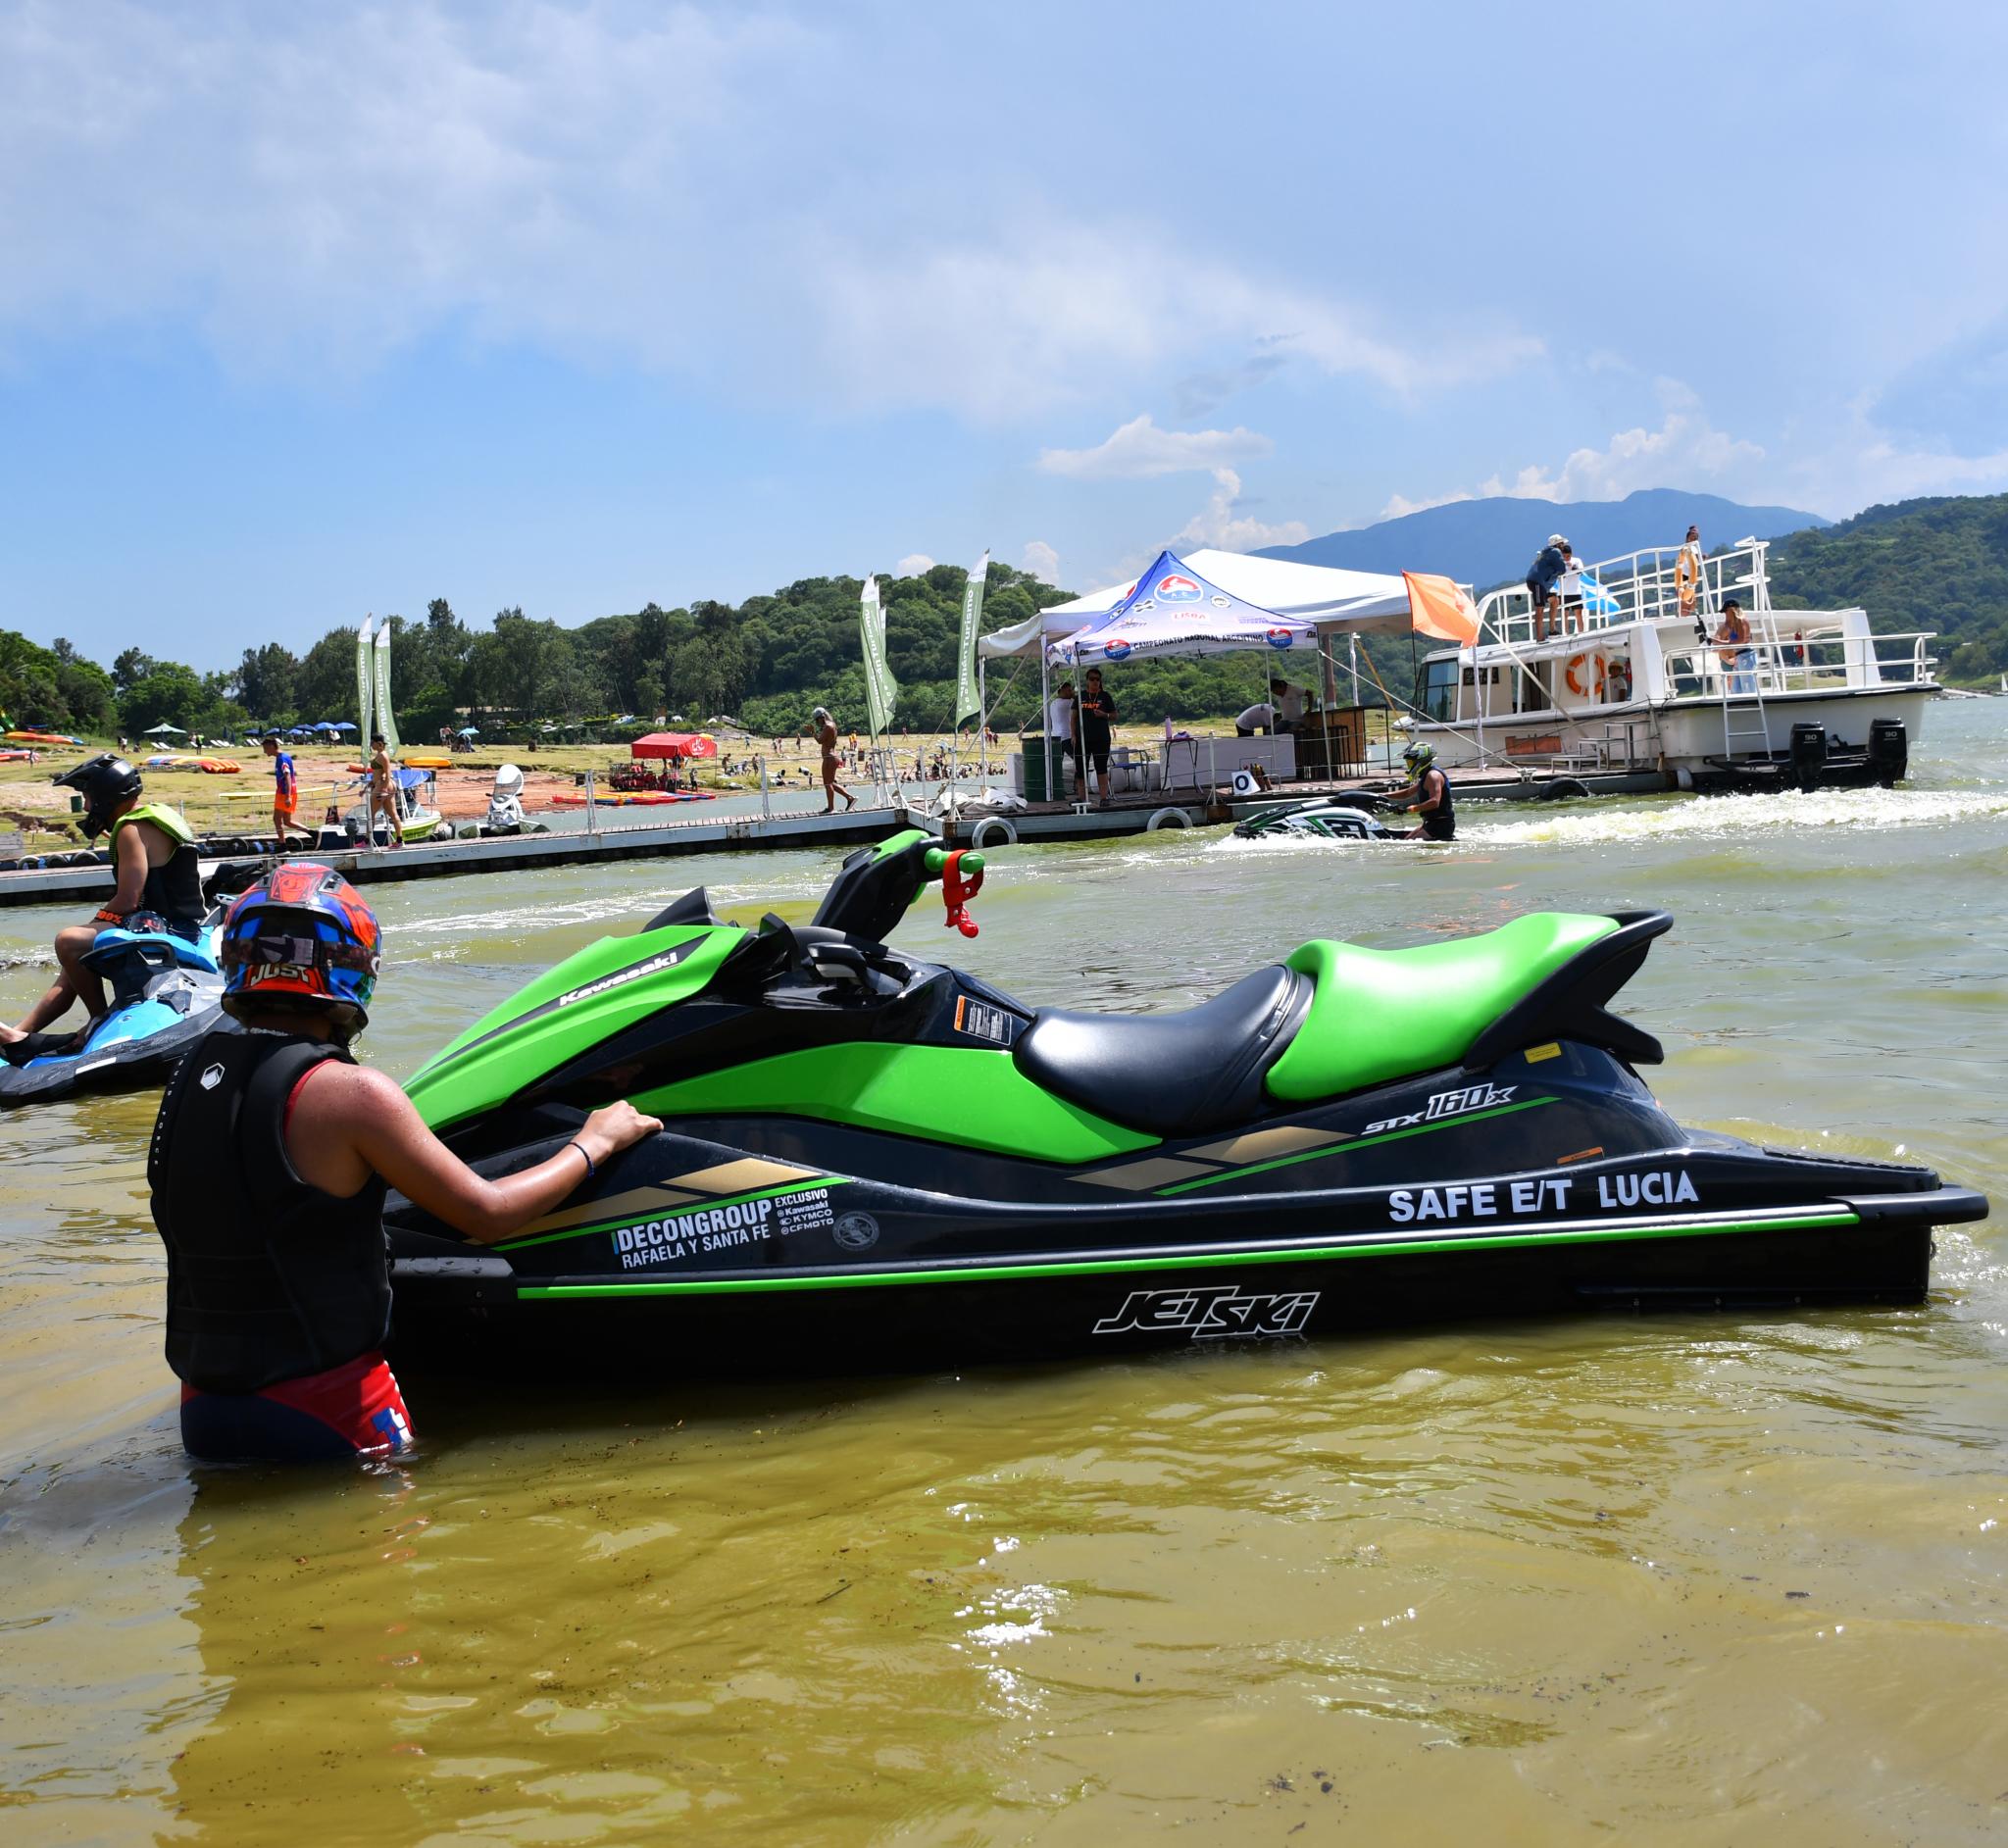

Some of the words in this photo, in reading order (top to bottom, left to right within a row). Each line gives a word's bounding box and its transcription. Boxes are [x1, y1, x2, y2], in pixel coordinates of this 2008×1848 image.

[963, 589, 974, 650] Turismo
[1133, 636, 1183, 650] CAMPEONATO
[1222, 633, 1264, 642] ARGENTINO
[559, 951, 678, 1006] Kawasaki
[775, 1188, 828, 1208] EXCLUSIVO
[785, 1201, 828, 1216] Kawasaki
[1388, 1184, 1497, 1223] SAFE
[1510, 1179, 1573, 1213] E/T
[1598, 1170, 1699, 1208] LUCIA
[619, 1199, 773, 1252] DECONGROUP
[790, 1217, 834, 1233] CFMOTO
[792, 1209, 832, 1223] KYMCO
[622, 1244, 686, 1269] RAFAELA
[687, 1239, 698, 1254] Y
[703, 1229, 749, 1252] SANTA
[753, 1224, 771, 1241] FE
